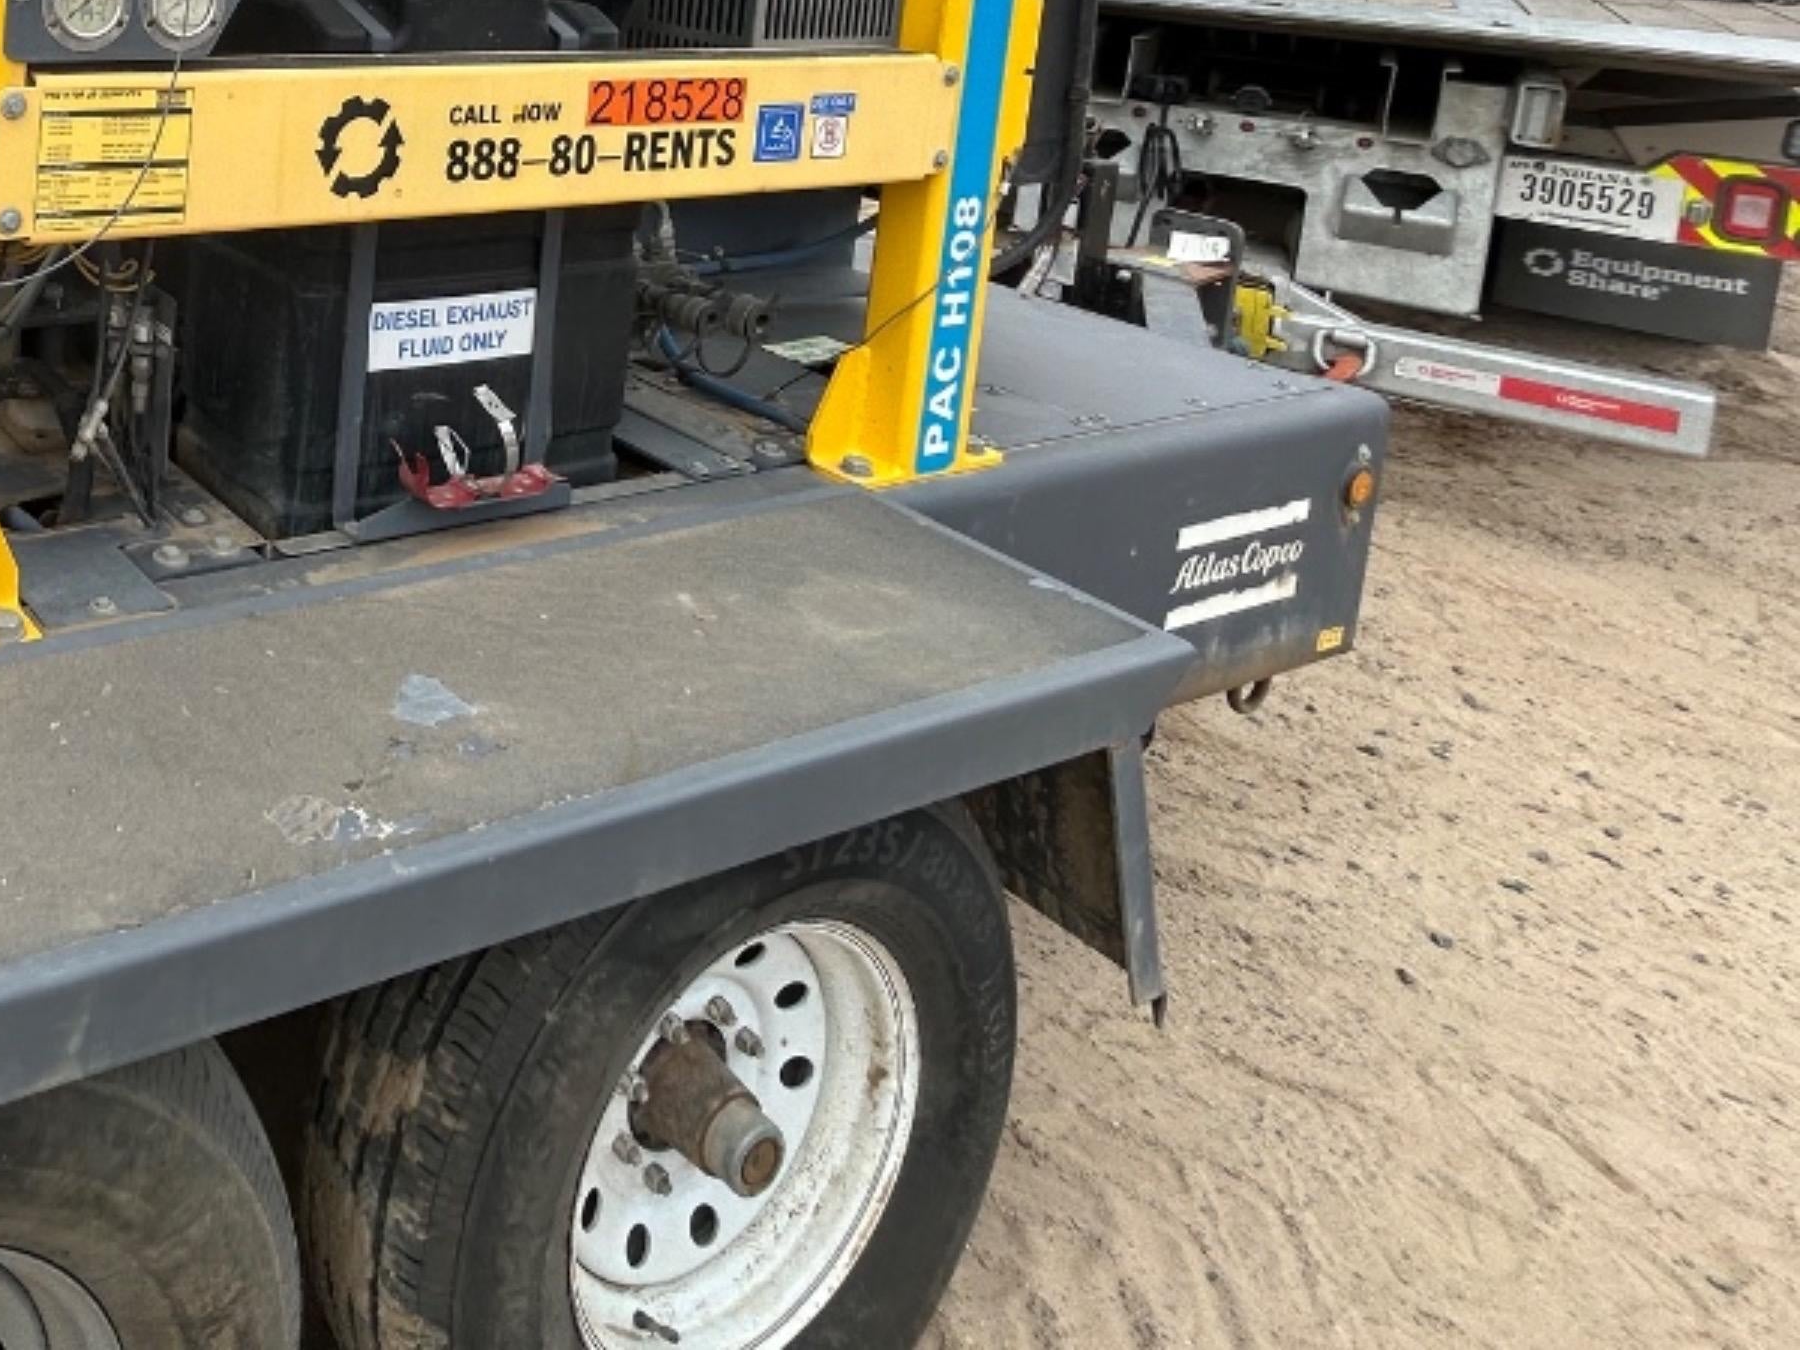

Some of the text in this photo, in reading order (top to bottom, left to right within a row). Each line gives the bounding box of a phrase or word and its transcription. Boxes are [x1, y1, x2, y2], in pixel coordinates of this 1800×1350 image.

[449, 104, 501, 126] CALL
[590, 78, 744, 125] 218528
[446, 128, 737, 182] 888-80-RENTS
[1550, 166, 1633, 187] INDIANA
[1519, 172, 1657, 220] 3905529
[1566, 269, 1662, 301] Share
[1570, 250, 1750, 296] Equipment
[372, 297, 535, 331] DIESEL EXHAUST
[922, 196, 982, 458] PAC H108
[397, 329, 508, 360] FLUID ONLY
